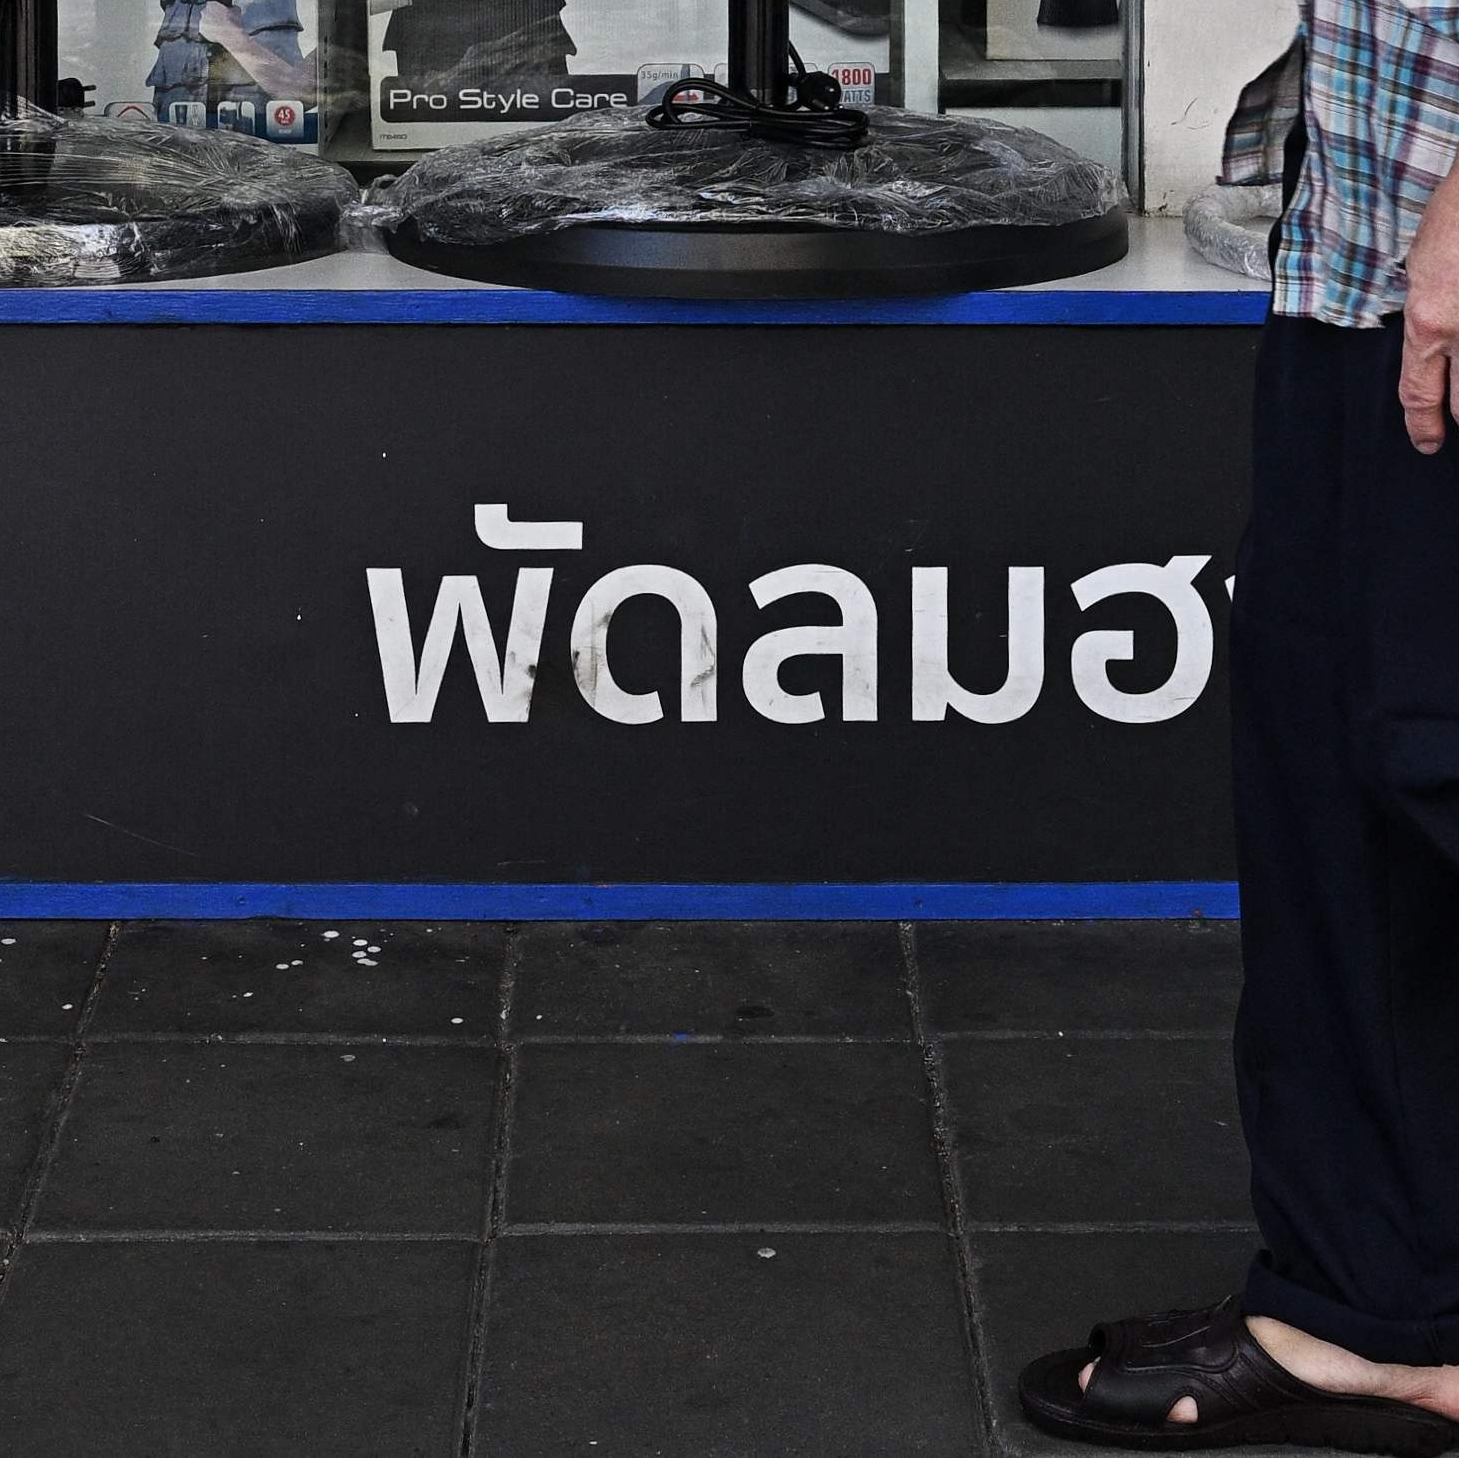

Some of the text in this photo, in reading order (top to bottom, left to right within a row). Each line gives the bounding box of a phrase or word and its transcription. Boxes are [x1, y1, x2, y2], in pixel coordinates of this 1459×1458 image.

[389, 88, 628, 114] Pro Style Care
[277, 108, 291, 120] 45
